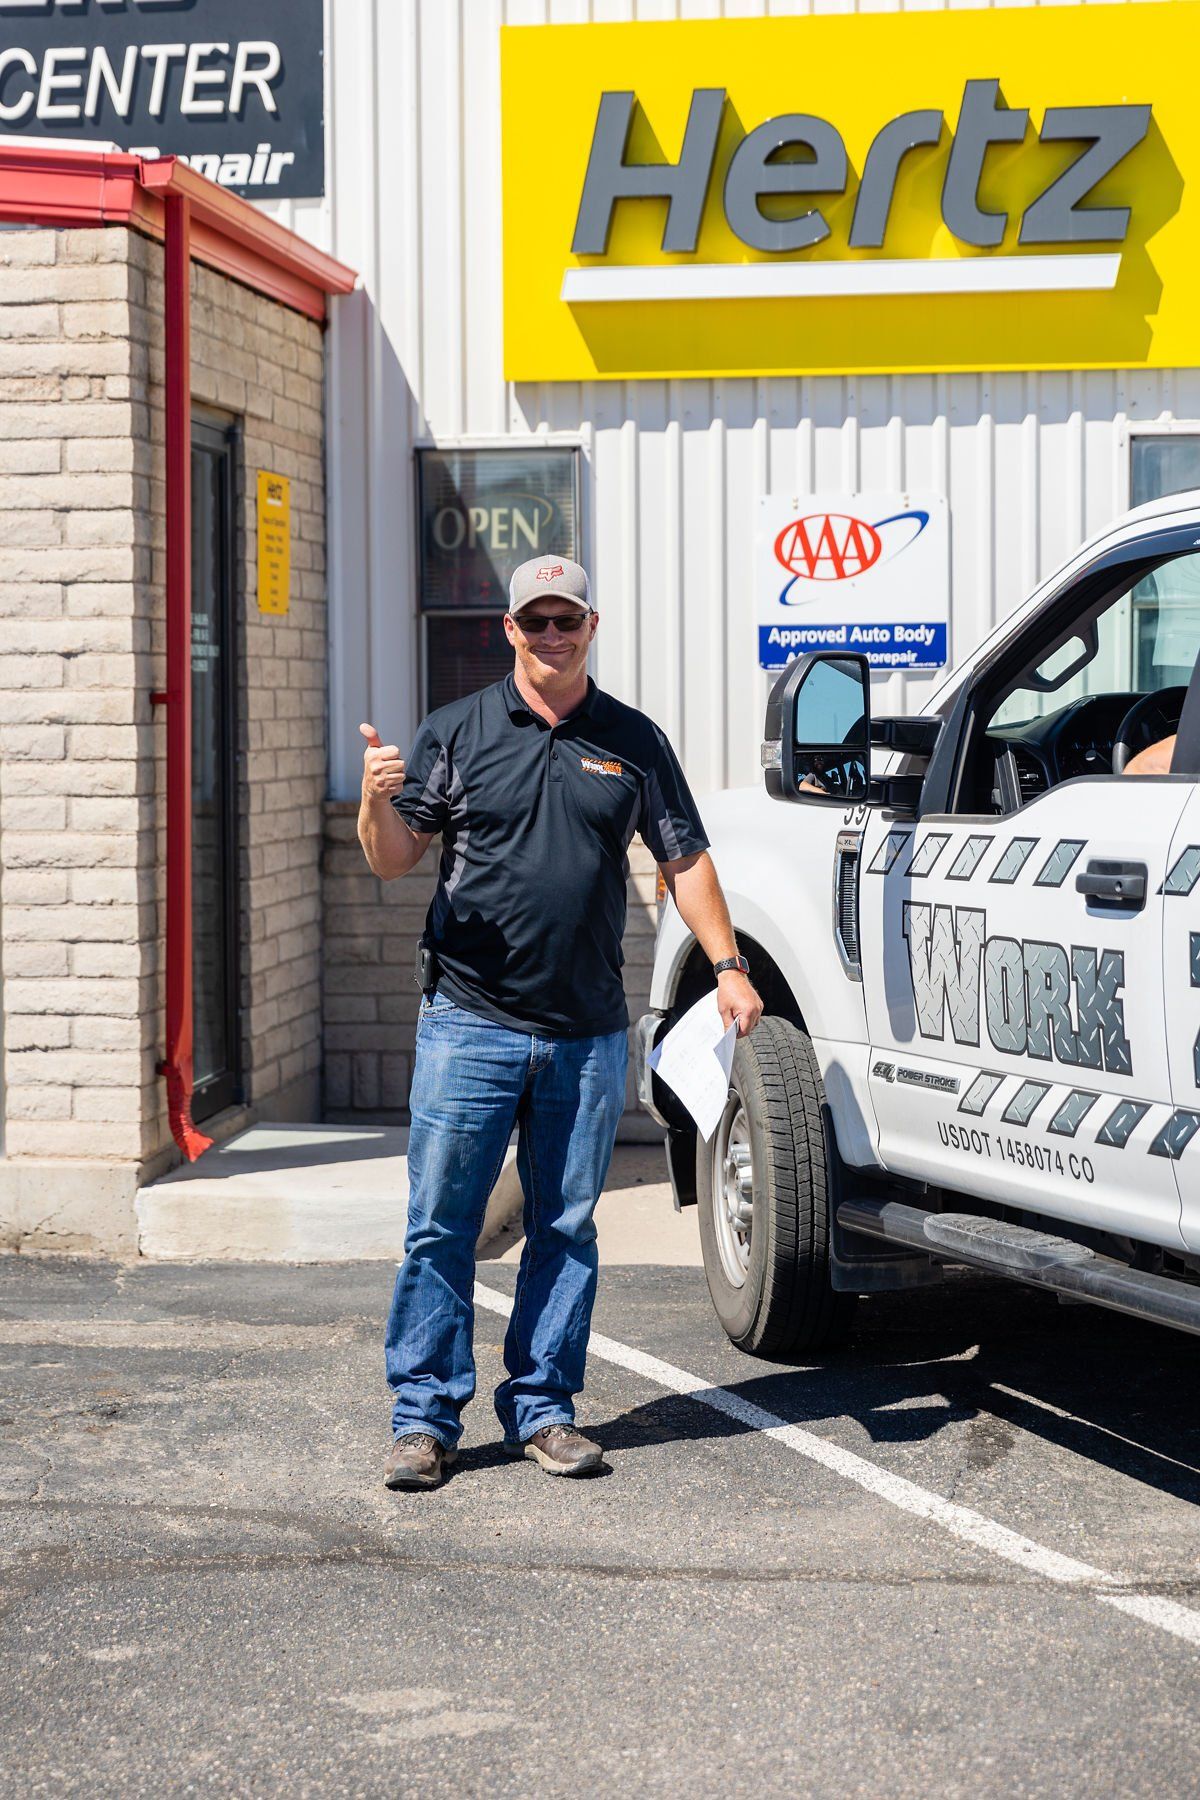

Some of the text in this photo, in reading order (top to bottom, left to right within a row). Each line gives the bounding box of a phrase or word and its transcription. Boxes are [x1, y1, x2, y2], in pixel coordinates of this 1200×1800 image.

[0, 41, 281, 120] CENTER
[571, 78, 1152, 253] Hertz
[433, 507, 539, 550] OPEN
[788, 514, 865, 579] AAA
[768, 625, 935, 647] Approved Auto Body
[902, 900, 1133, 1076] WORK
[897, 1068, 923, 1081] POWER
[925, 1074, 956, 1088] STROKE
[937, 1121, 1095, 1184] USDOT 1458074 CO
